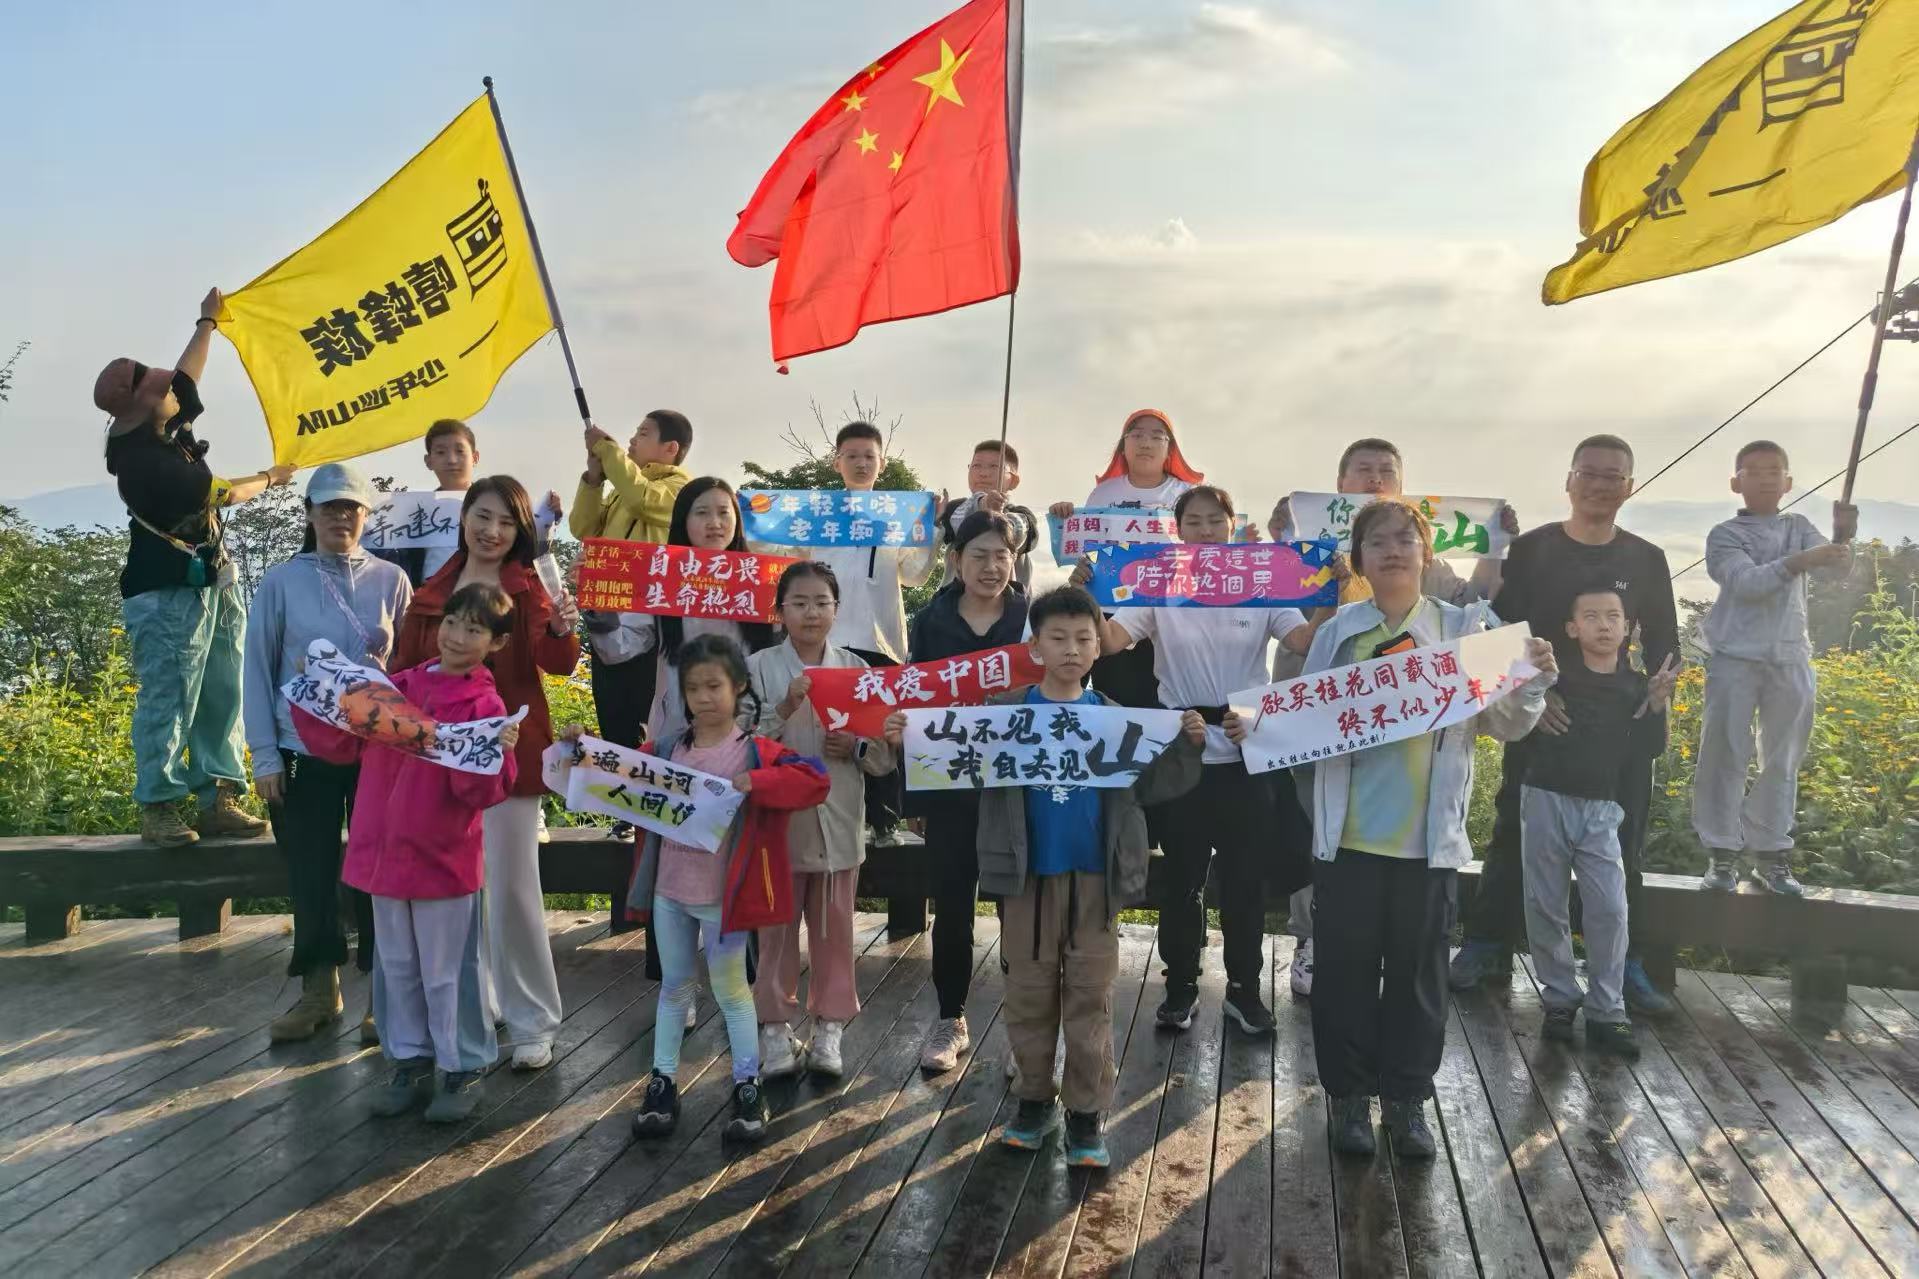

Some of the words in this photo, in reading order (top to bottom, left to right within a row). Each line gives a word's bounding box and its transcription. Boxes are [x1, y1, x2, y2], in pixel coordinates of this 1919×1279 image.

[780, 490, 897, 516] 年轻不嗨
[364, 503, 459, 547] 等风来不
[788, 519, 906, 543] 老年痴呆
[648, 545, 760, 585] 自由无畏
[645, 582, 759, 616] 生命热烈
[854, 650, 1012, 705] 我爱中国
[1253, 650, 1459, 732] 欲买桂花同载酒
[924, 707, 1092, 745] 山不见我
